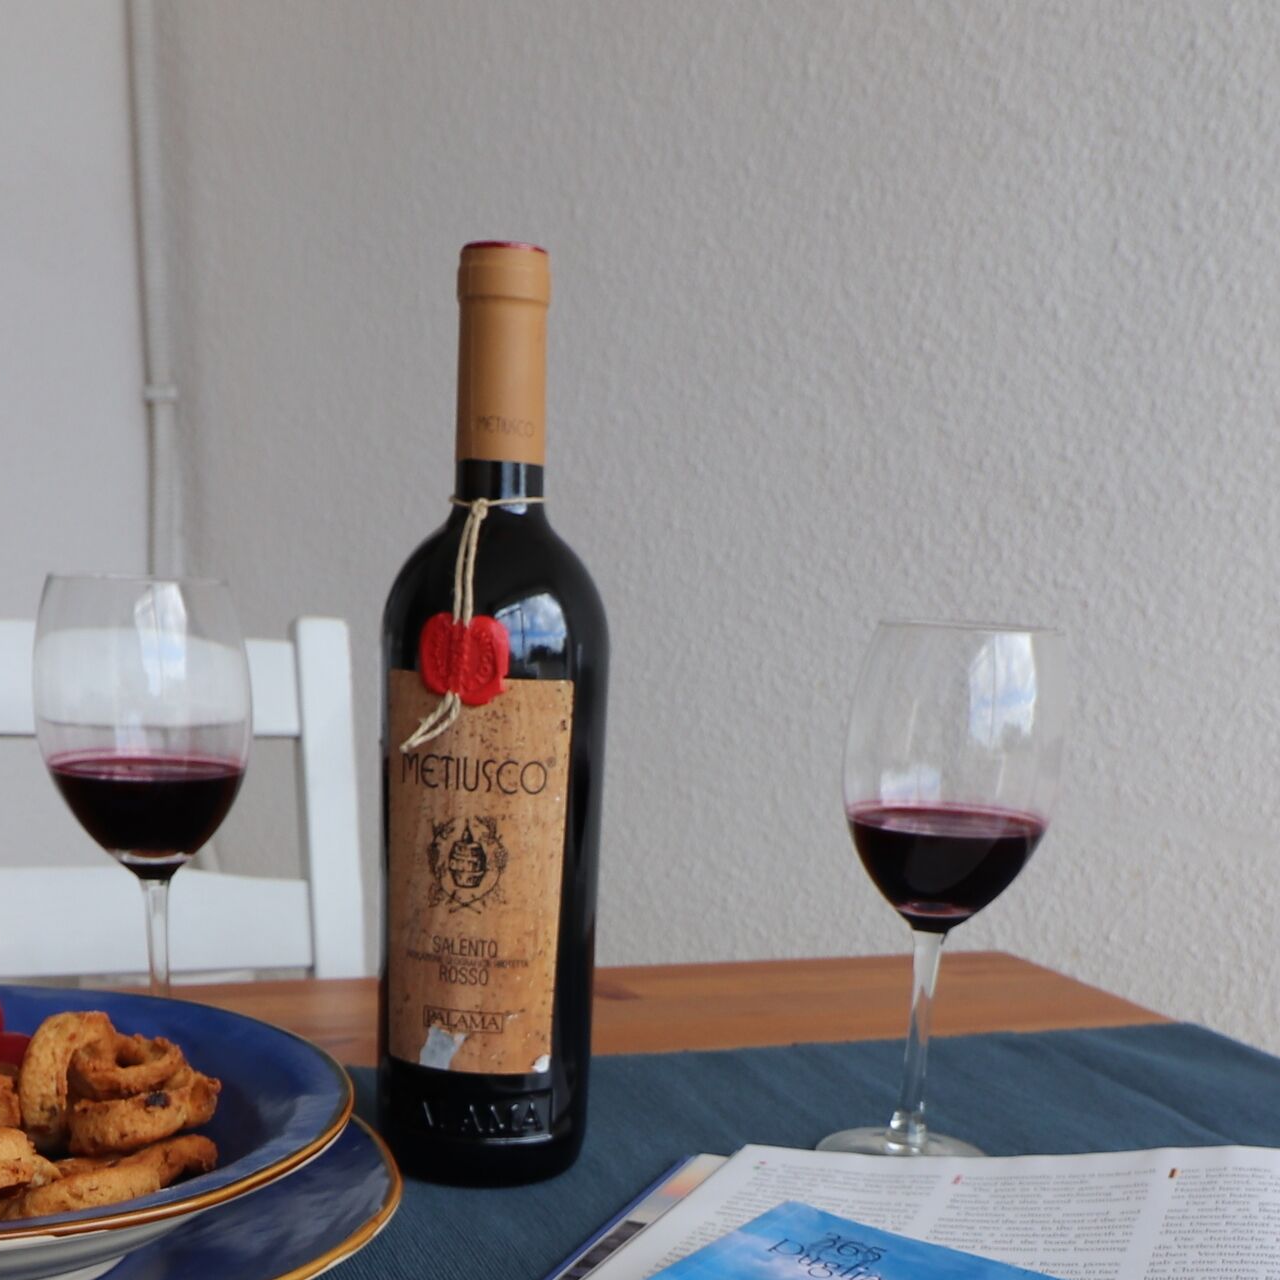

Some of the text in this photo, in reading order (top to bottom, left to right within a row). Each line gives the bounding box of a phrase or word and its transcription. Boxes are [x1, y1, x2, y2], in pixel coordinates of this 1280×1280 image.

[402, 753, 547, 795] METIUSCO
[432, 935, 498, 958] SALENTO
[439, 966, 489, 986] ROSSO
[818, 1232, 887, 1263] 365
